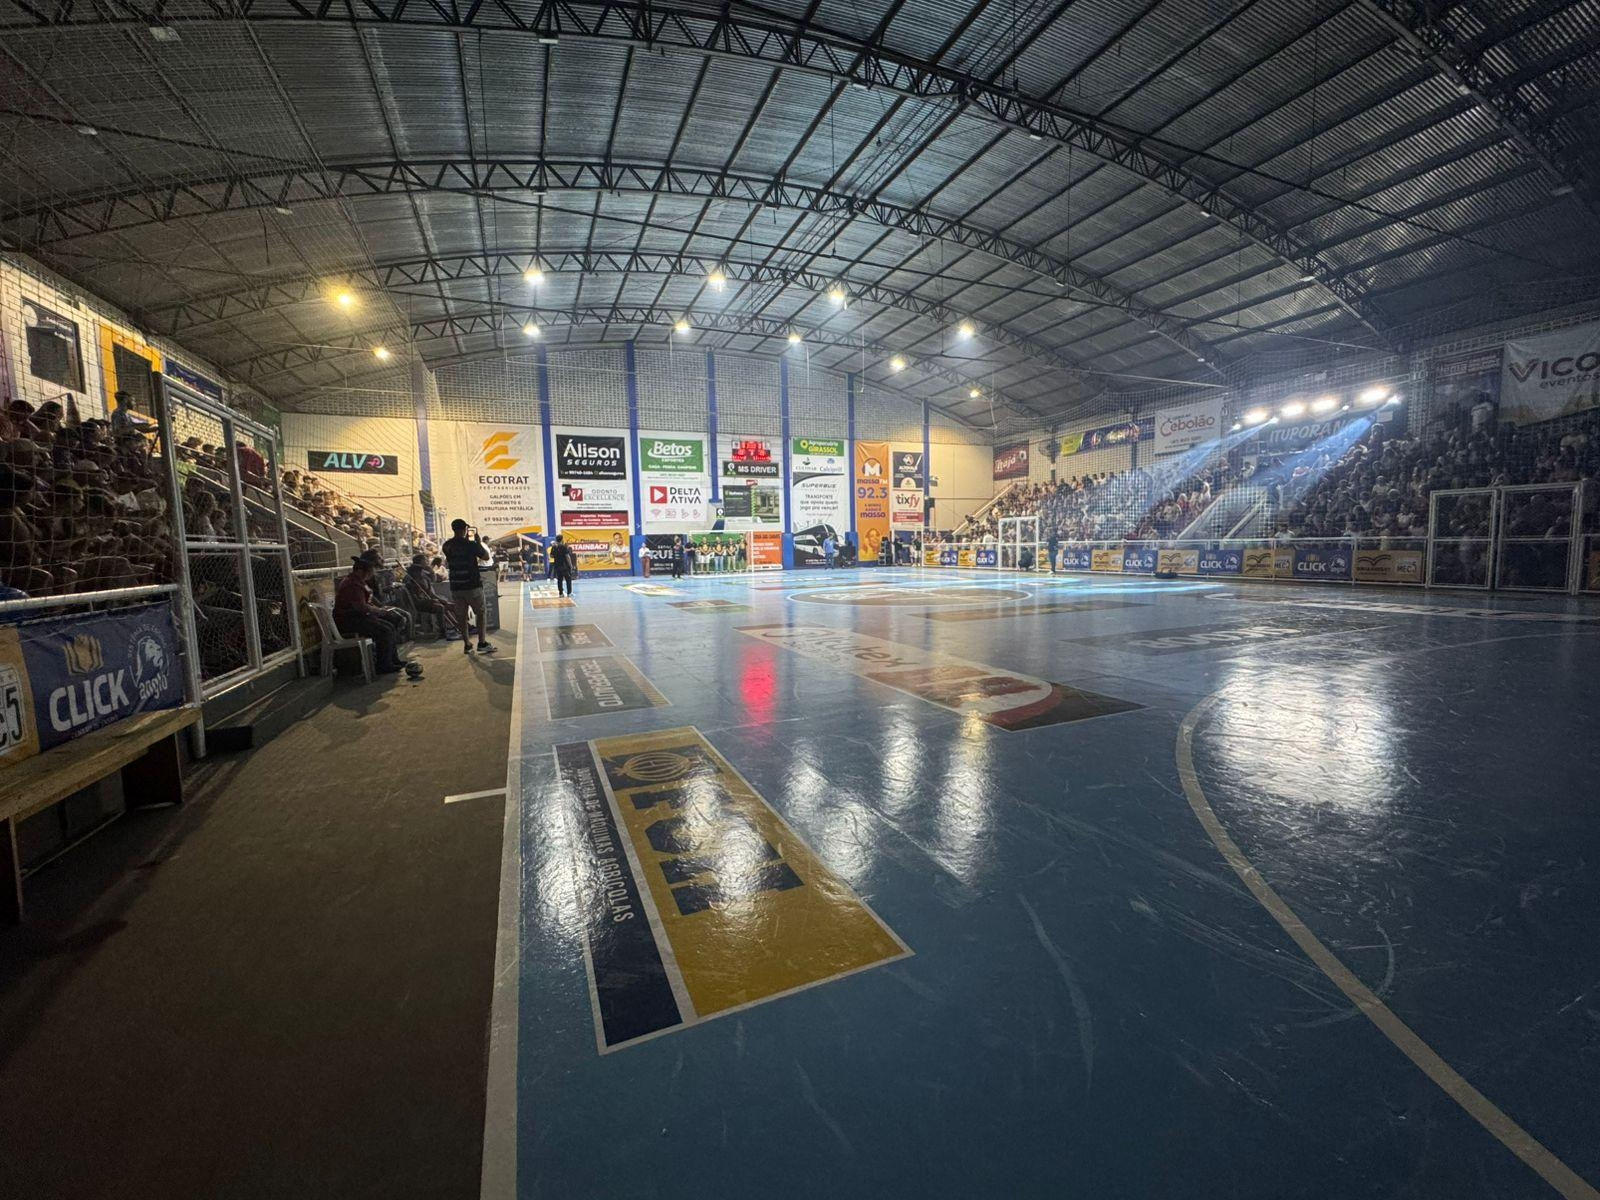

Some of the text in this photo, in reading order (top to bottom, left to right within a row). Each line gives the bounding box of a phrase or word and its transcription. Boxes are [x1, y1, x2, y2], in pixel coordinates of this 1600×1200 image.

[1160, 414, 1216, 437] Cebolão
[1270, 419, 1347, 442] ITUPORAN
[563, 439, 620, 459] Álison
[653, 441, 692, 455] Betos
[478, 475, 529, 484] ECOTRAT
[669, 486, 701, 496] DELTA
[857, 487, 888, 499] 92.3
[670, 495, 702, 504] ATIVA
[896, 494, 920, 507] tixfy
[1125, 559, 1143, 567] CLICK
[1200, 560, 1222, 569] CLICK
[1297, 561, 1327, 572] CLICK
[138, 672, 168, 701] anglo
[49, 669, 130, 732] CLICK
[600, 857, 634, 923] AGRÍCOLAS
